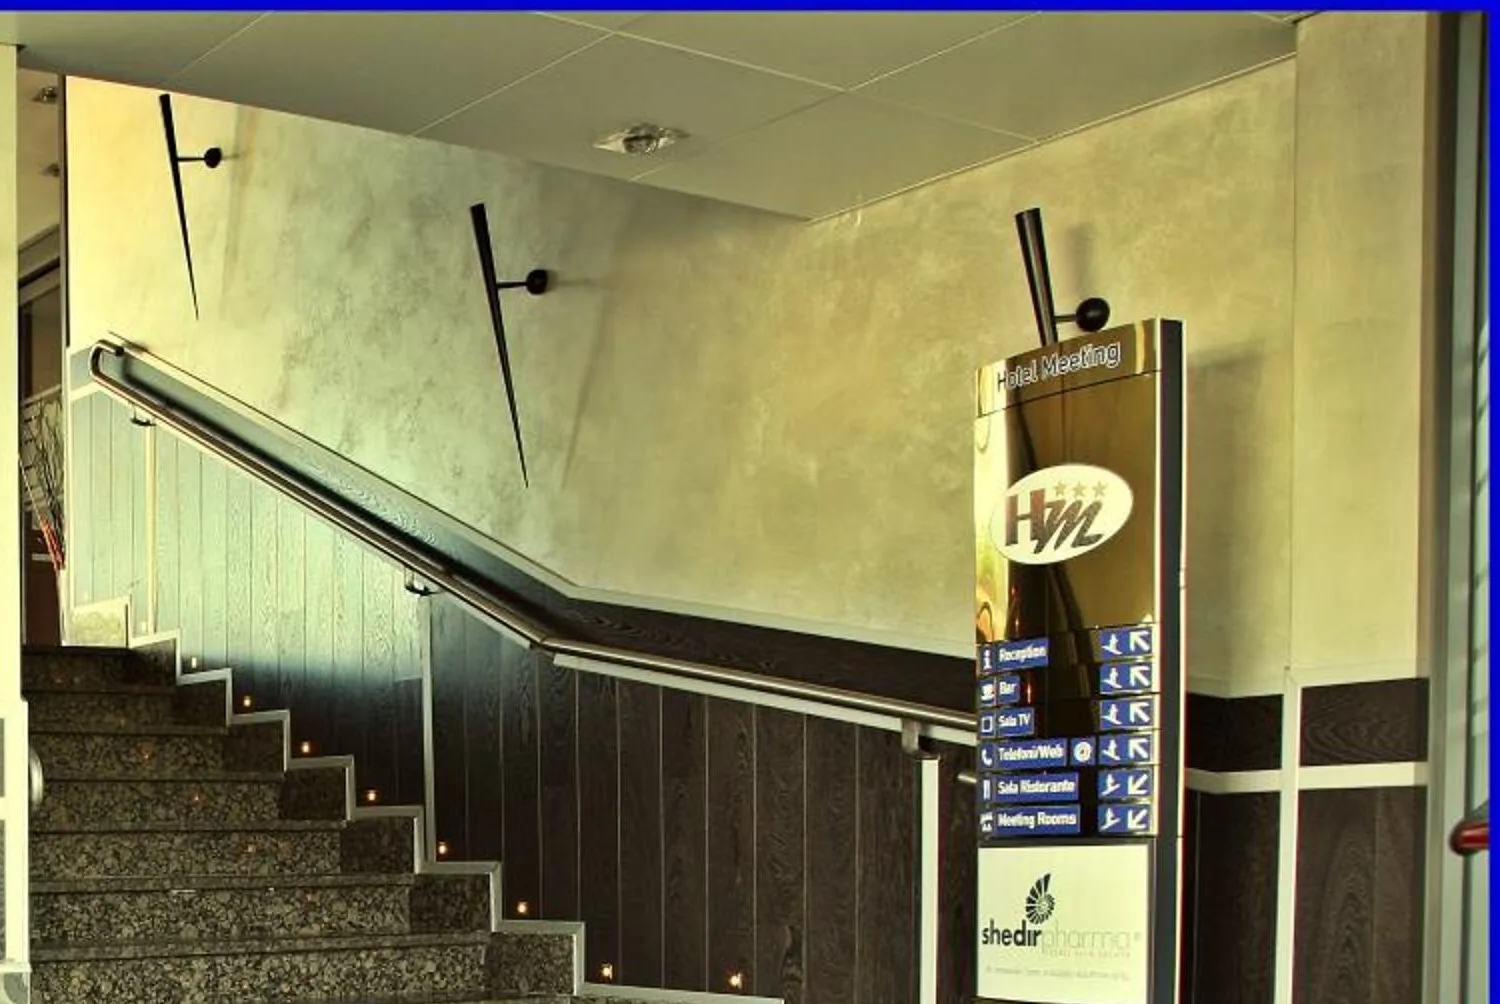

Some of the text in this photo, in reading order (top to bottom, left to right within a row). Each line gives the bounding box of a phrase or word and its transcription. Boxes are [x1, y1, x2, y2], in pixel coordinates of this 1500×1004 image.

[998, 342, 1121, 392] Hotel Meeting
[999, 645, 1047, 662] Reception
[999, 681, 1015, 695] Bar
[999, 714, 1031, 727] Sala TV
[999, 745, 1064, 761] Telefoni/Web
[998, 779, 1076, 795] Sala Ristorante
[998, 811, 1077, 829] Meeting Rooms
